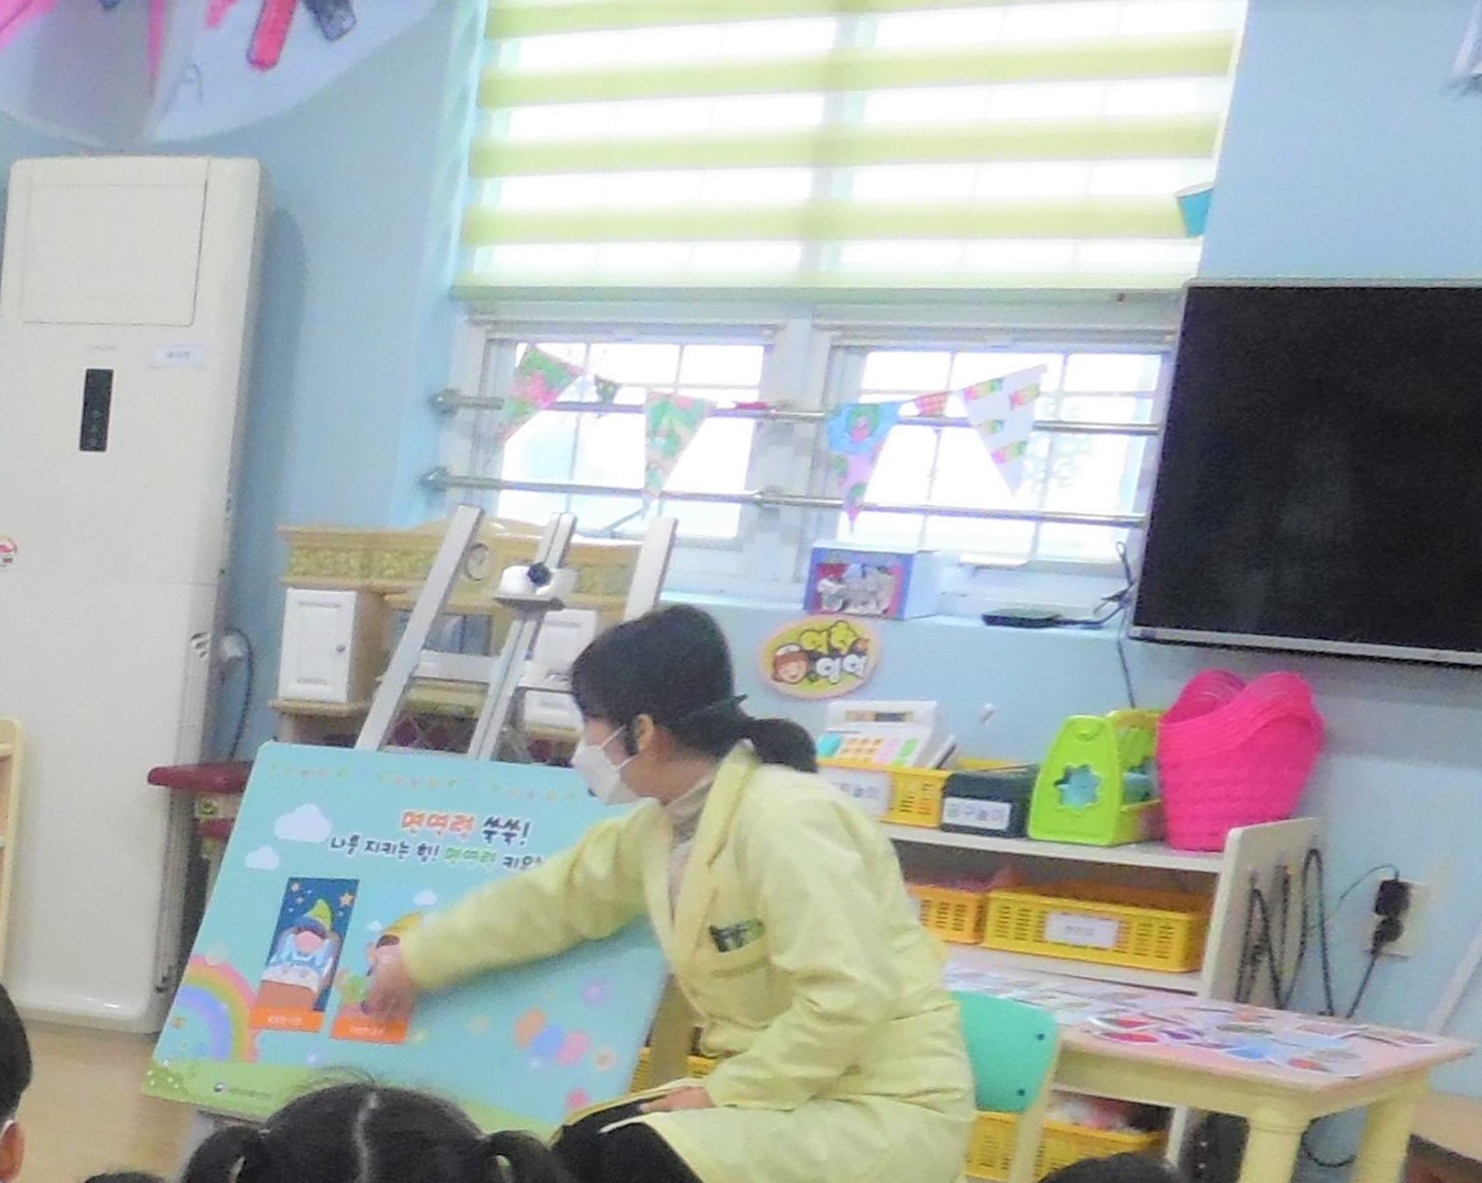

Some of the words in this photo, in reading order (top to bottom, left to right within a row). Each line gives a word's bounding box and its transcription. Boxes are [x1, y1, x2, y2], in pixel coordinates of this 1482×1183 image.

[330, 834, 360, 856] 나를
[364, 840, 410, 860] 지키는
[417, 842, 440, 863] 힘!
[502, 854, 543, 871] 키우
